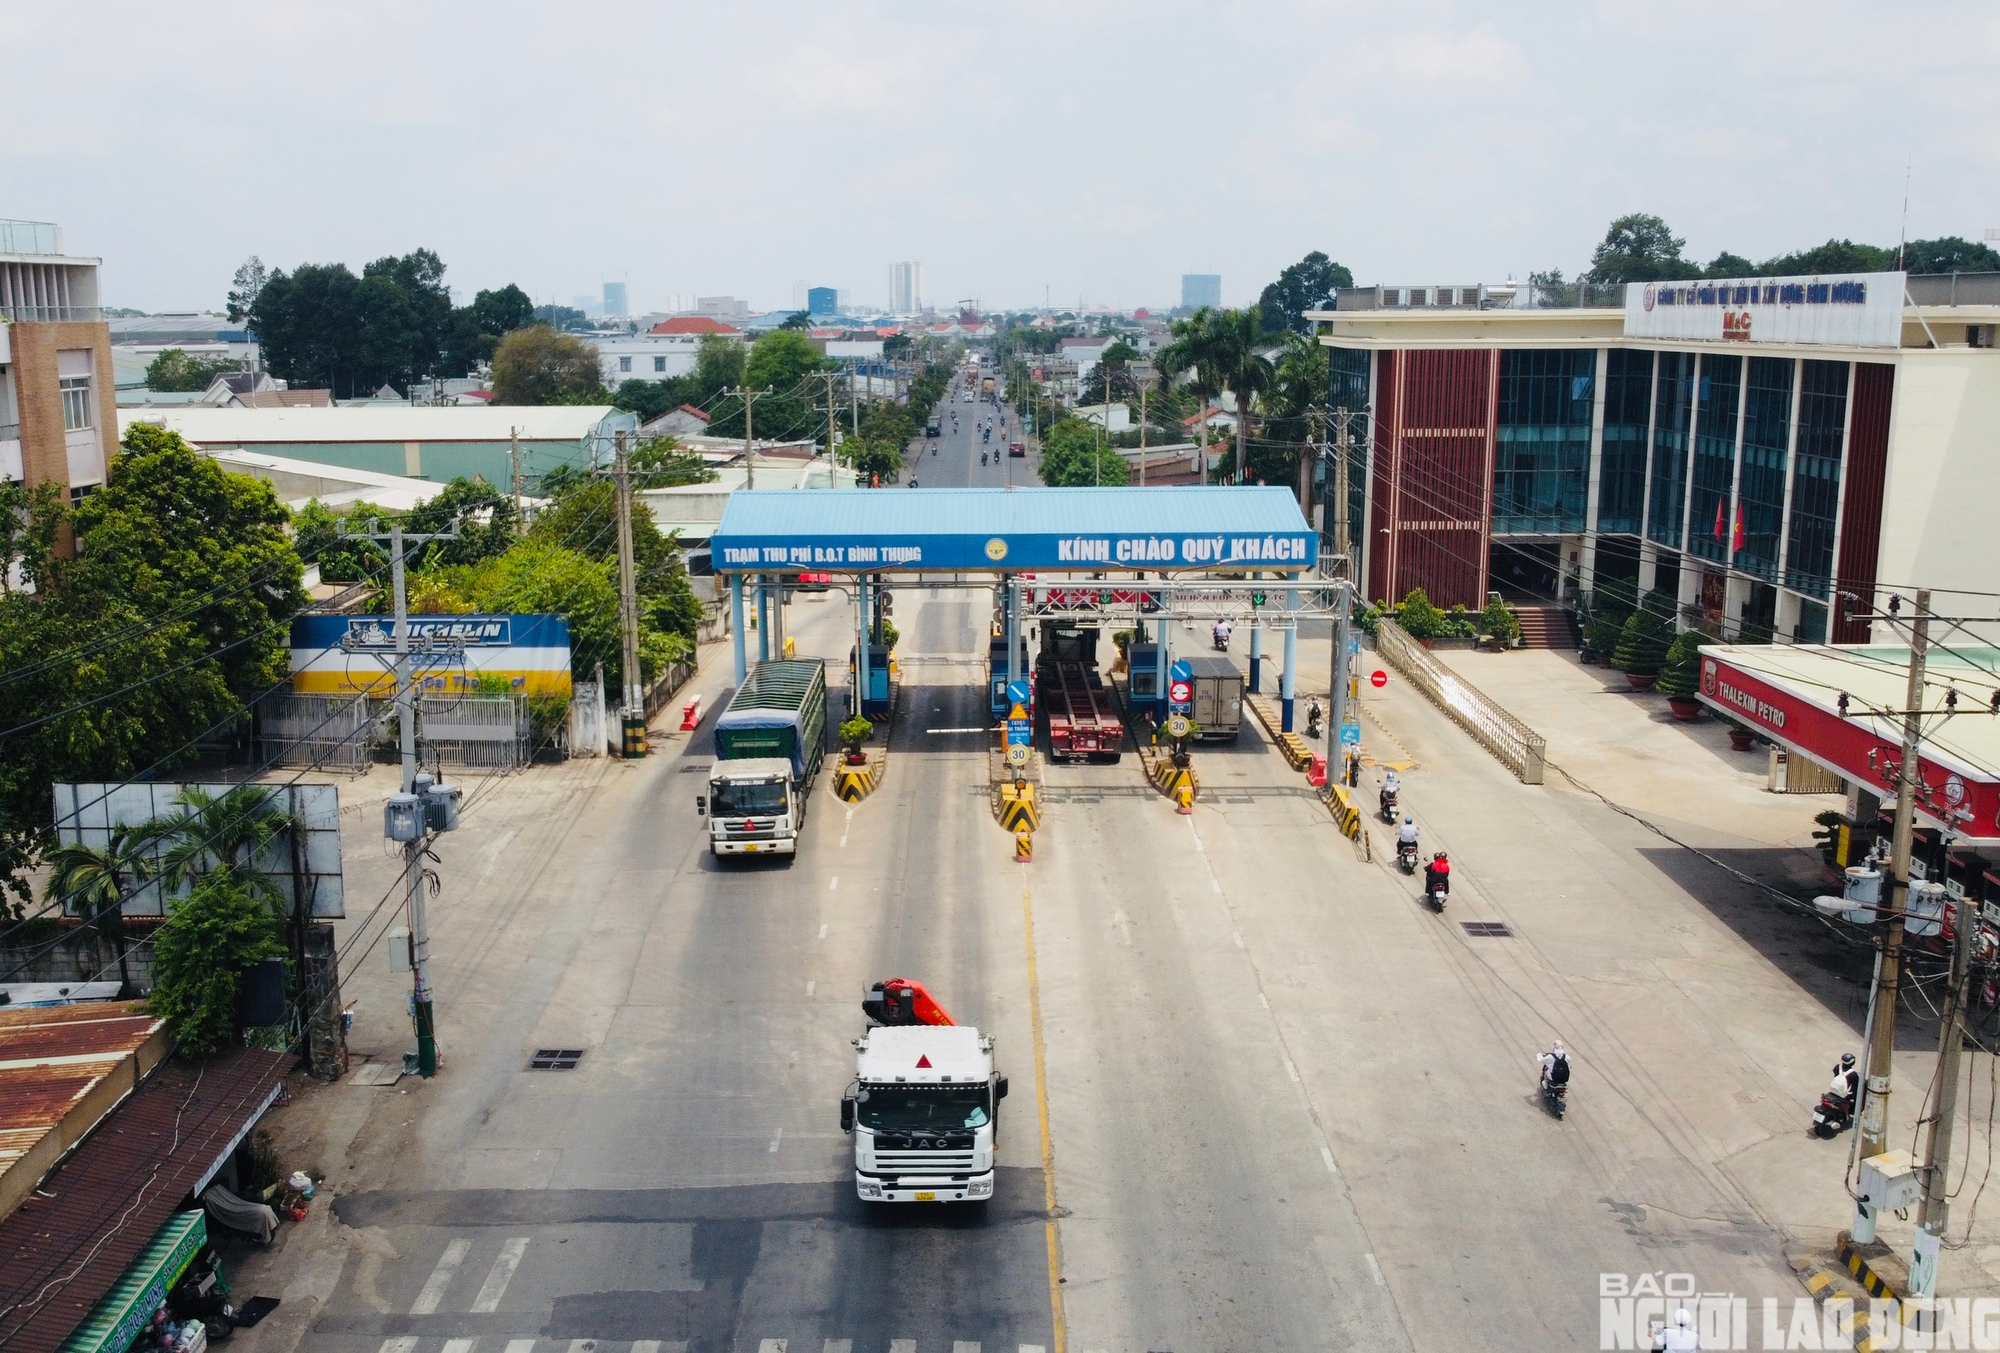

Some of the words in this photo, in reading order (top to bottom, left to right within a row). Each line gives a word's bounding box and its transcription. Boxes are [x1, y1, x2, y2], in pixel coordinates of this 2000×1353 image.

[724, 548, 760, 564] TRẠM
[763, 548, 788, 562] THU
[790, 545, 811, 563] PHÍ
[815, 547, 844, 563] B.O.T
[848, 545, 878, 562] BÌNH
[881, 546, 921, 562] THUNG
[1058, 536, 1110, 561] KÍNH
[1116, 536, 1175, 561] CHÀO
[1182, 538, 1225, 561] QUÝ
[1231, 535, 1306, 560] KHÁCH
[1719, 681, 1757, 713] THALEXIM
[1758, 701, 1785, 728] PETRO
[1172, 721, 1185, 731] 30
[1012, 750, 1025, 760] 30
[902, 1139, 948, 1149] JAC
